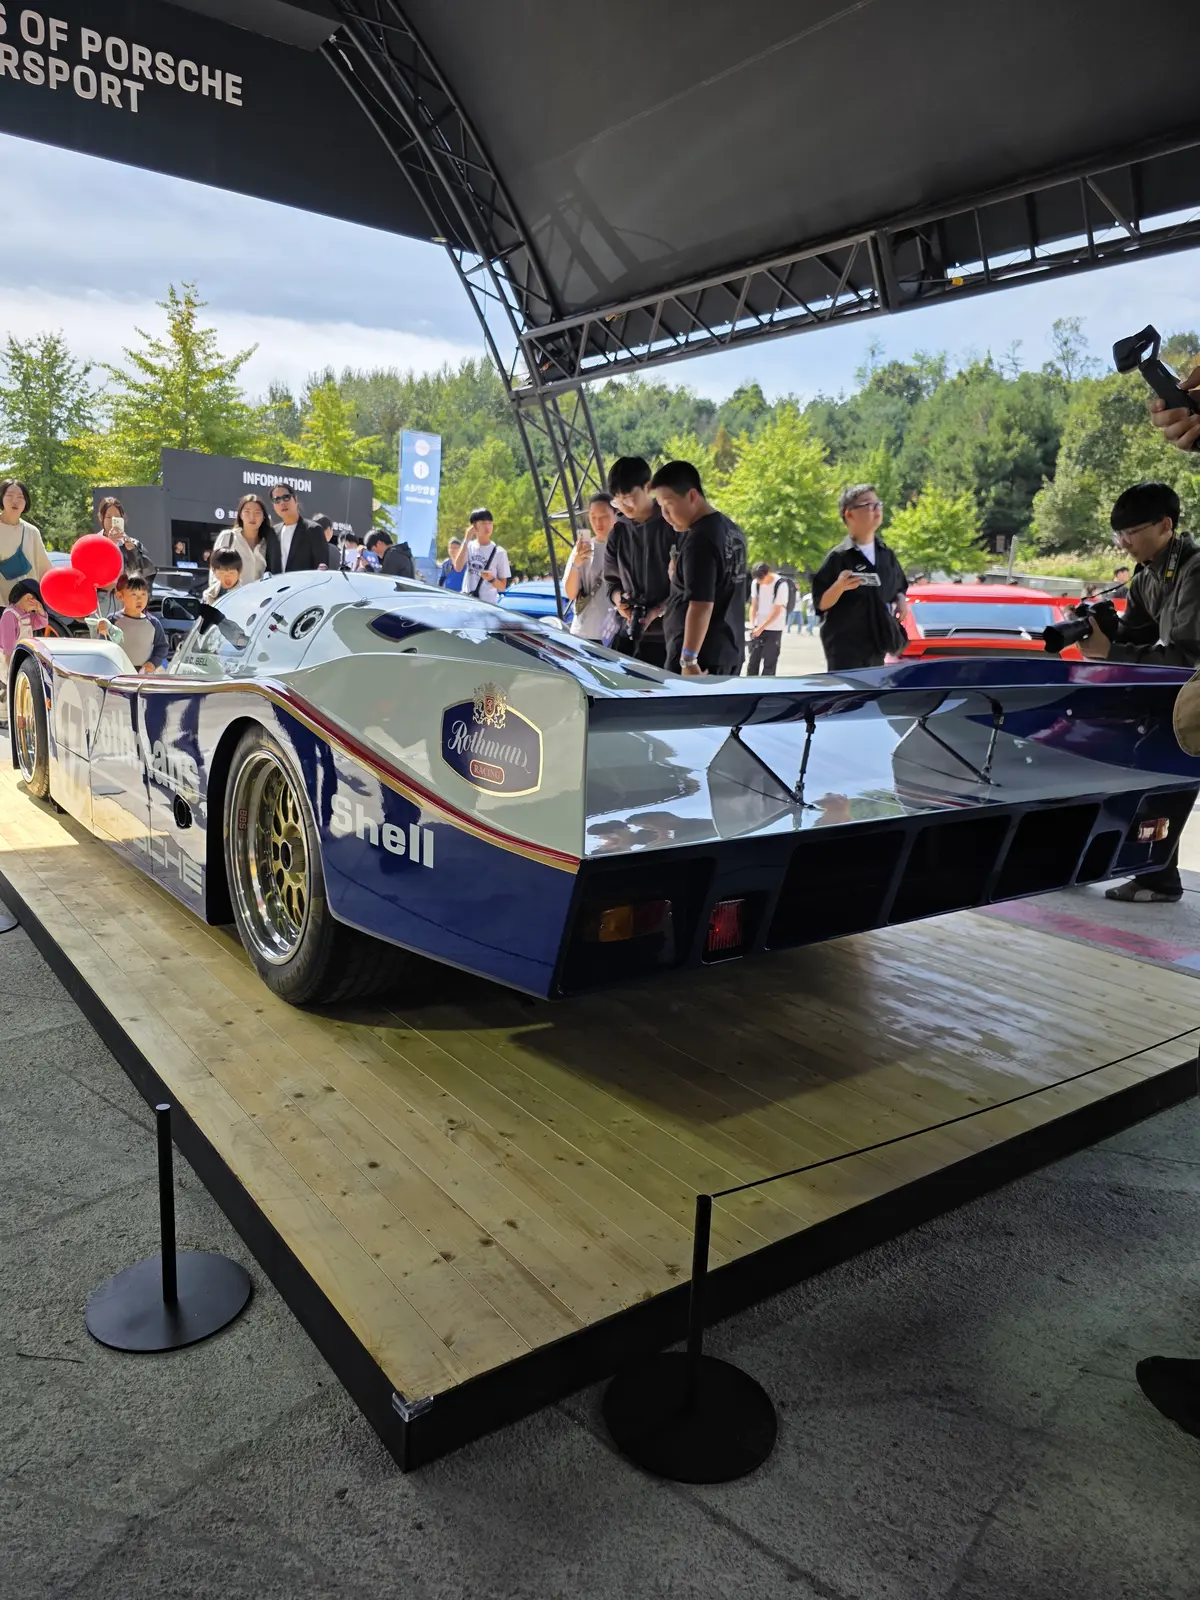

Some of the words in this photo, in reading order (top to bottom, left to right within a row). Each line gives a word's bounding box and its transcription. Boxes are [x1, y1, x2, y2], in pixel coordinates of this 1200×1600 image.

[20, 9, 68, 51] OF
[80, 27, 243, 107] PORSCHE
[447, 719, 531, 774] Rothmans
[474, 764, 501, 779] RACING
[239, 809, 248, 830] BBS
[330, 793, 434, 869] Shell
